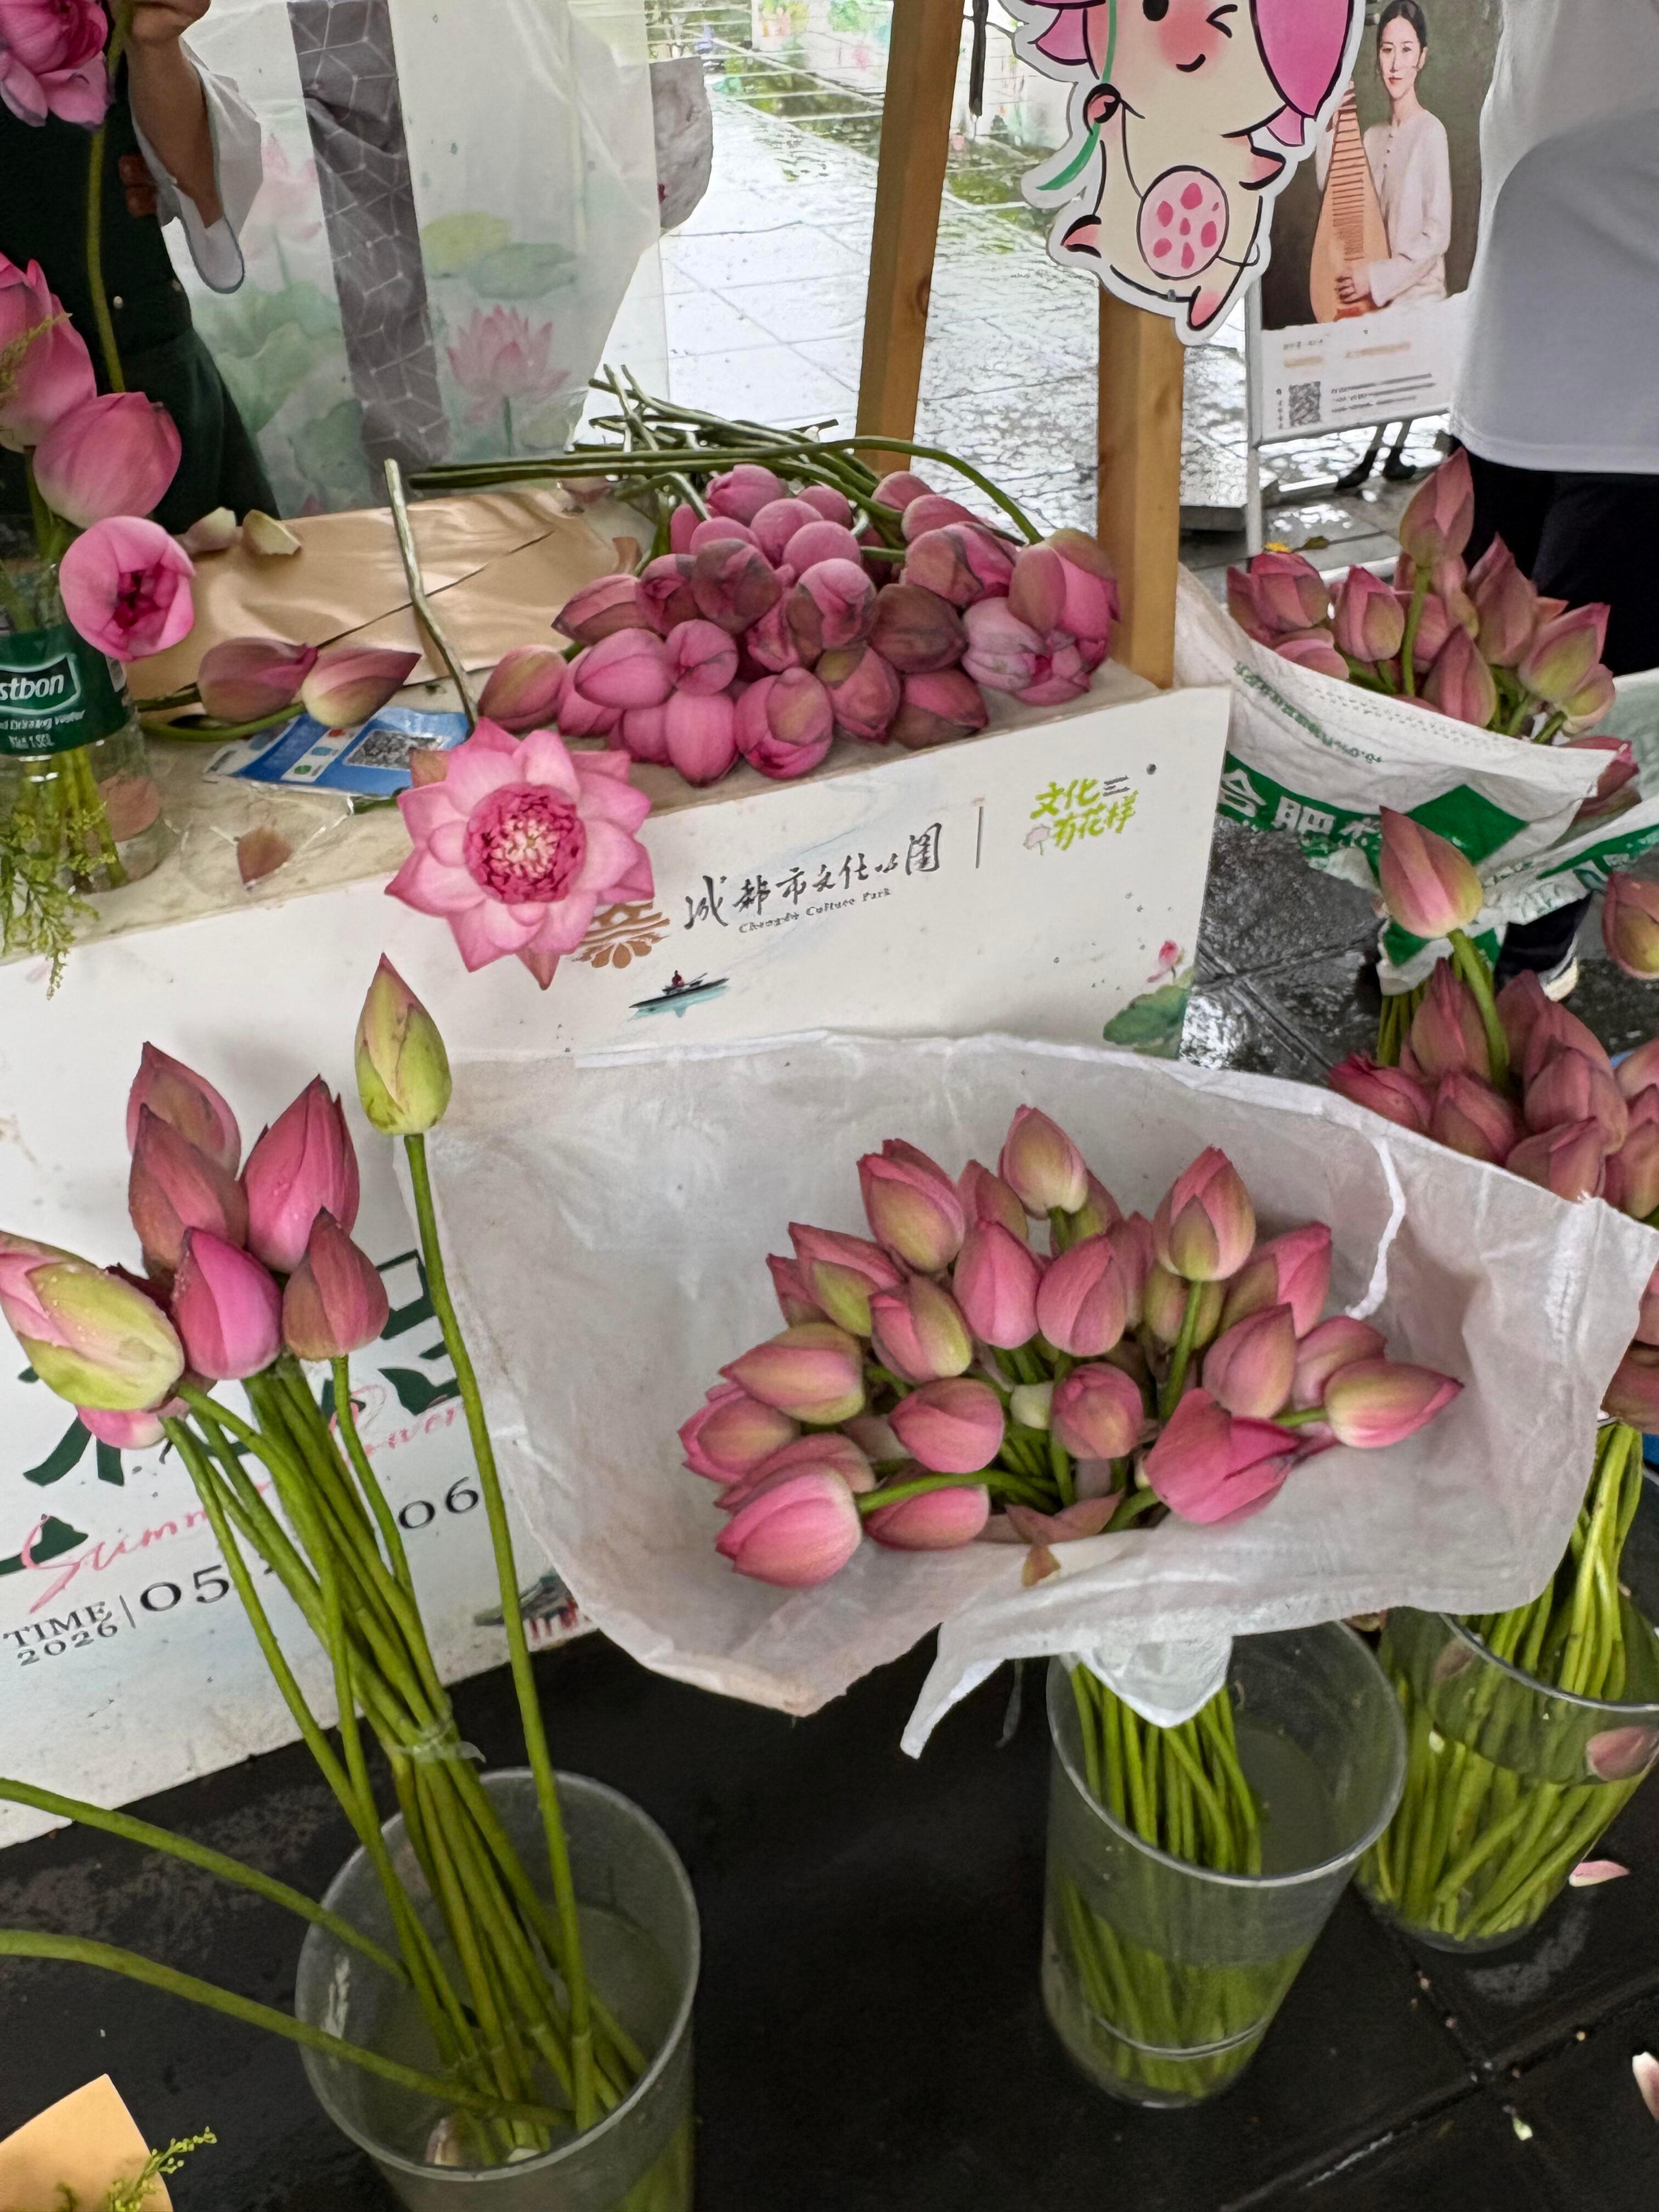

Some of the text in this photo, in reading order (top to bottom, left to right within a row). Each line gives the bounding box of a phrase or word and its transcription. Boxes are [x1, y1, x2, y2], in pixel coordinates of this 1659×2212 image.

[1030, 778, 1100, 820] 文化
[140, 1476, 479, 1612] 05 06
[3, 1601, 106, 1647] TIME
[17, 1611, 119, 1666] 2026
